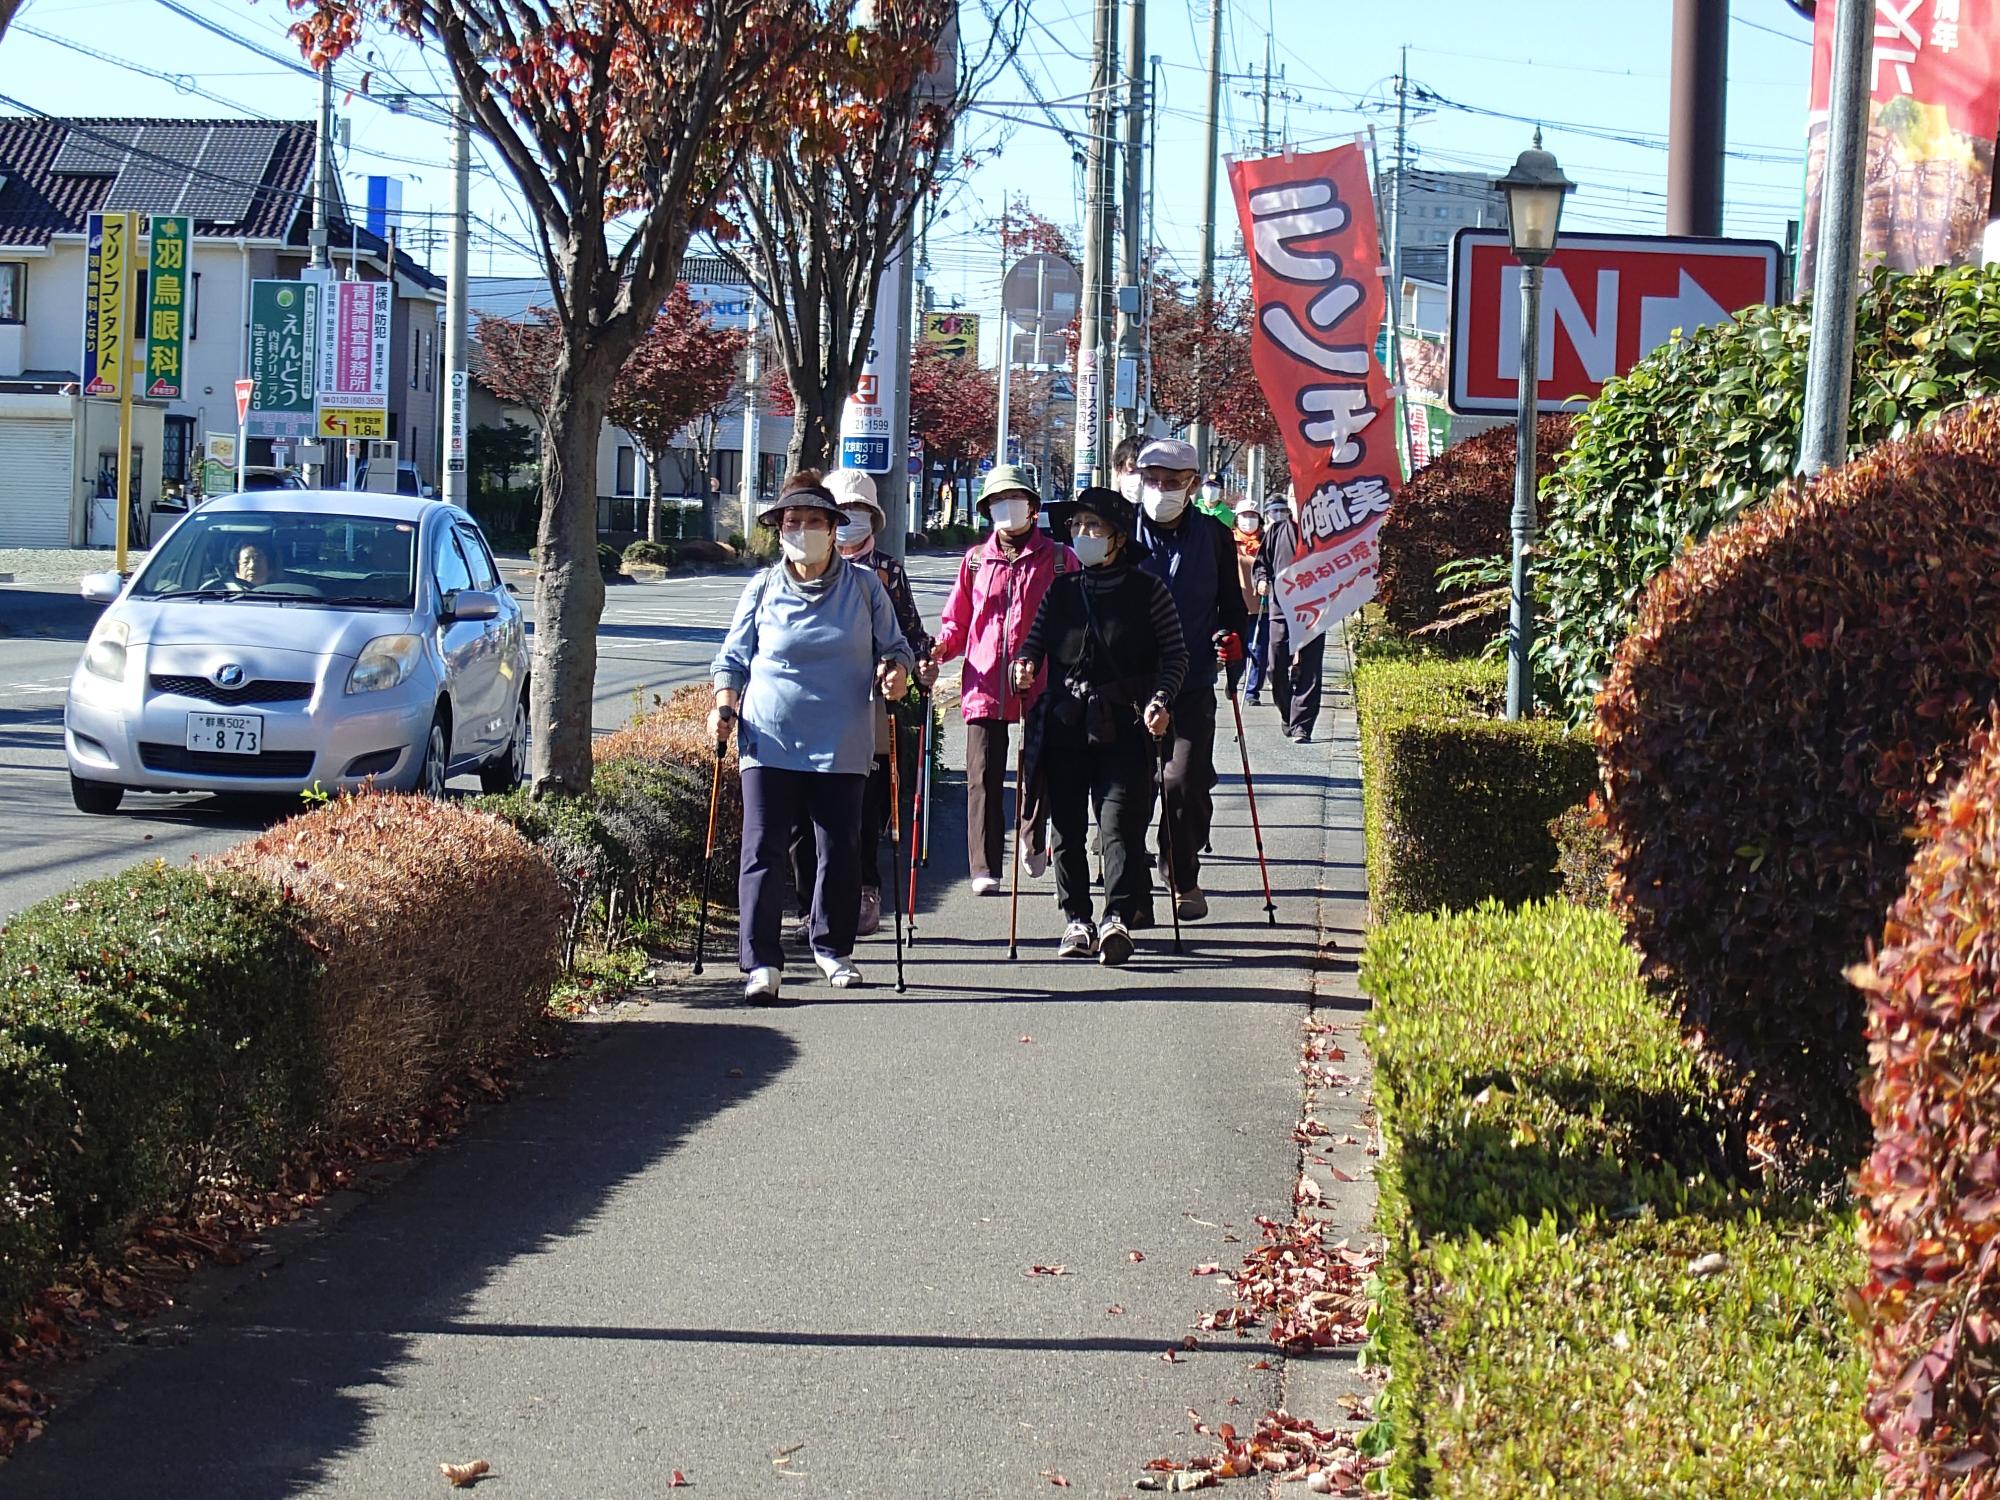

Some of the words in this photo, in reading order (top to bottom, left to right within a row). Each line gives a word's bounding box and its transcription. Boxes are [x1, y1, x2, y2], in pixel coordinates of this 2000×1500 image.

[87, 255, 100, 353] 羽鳥眼科となり
[101, 223, 123, 370] マリンコンタクト
[151, 239, 183, 377] 羽鳥眼科
[349, 285, 371, 391] 青葉調査事務所
[374, 313, 387, 339] 防犯
[375, 286, 388, 311] 探偵
[1498, 265, 1619, 383] IN
[267, 329, 280, 406] 内科クリニック
[280, 313, 301, 406] えんどう
[844, 442, 884, 454] 文京町3丁目
[854, 454, 868, 464] 32
